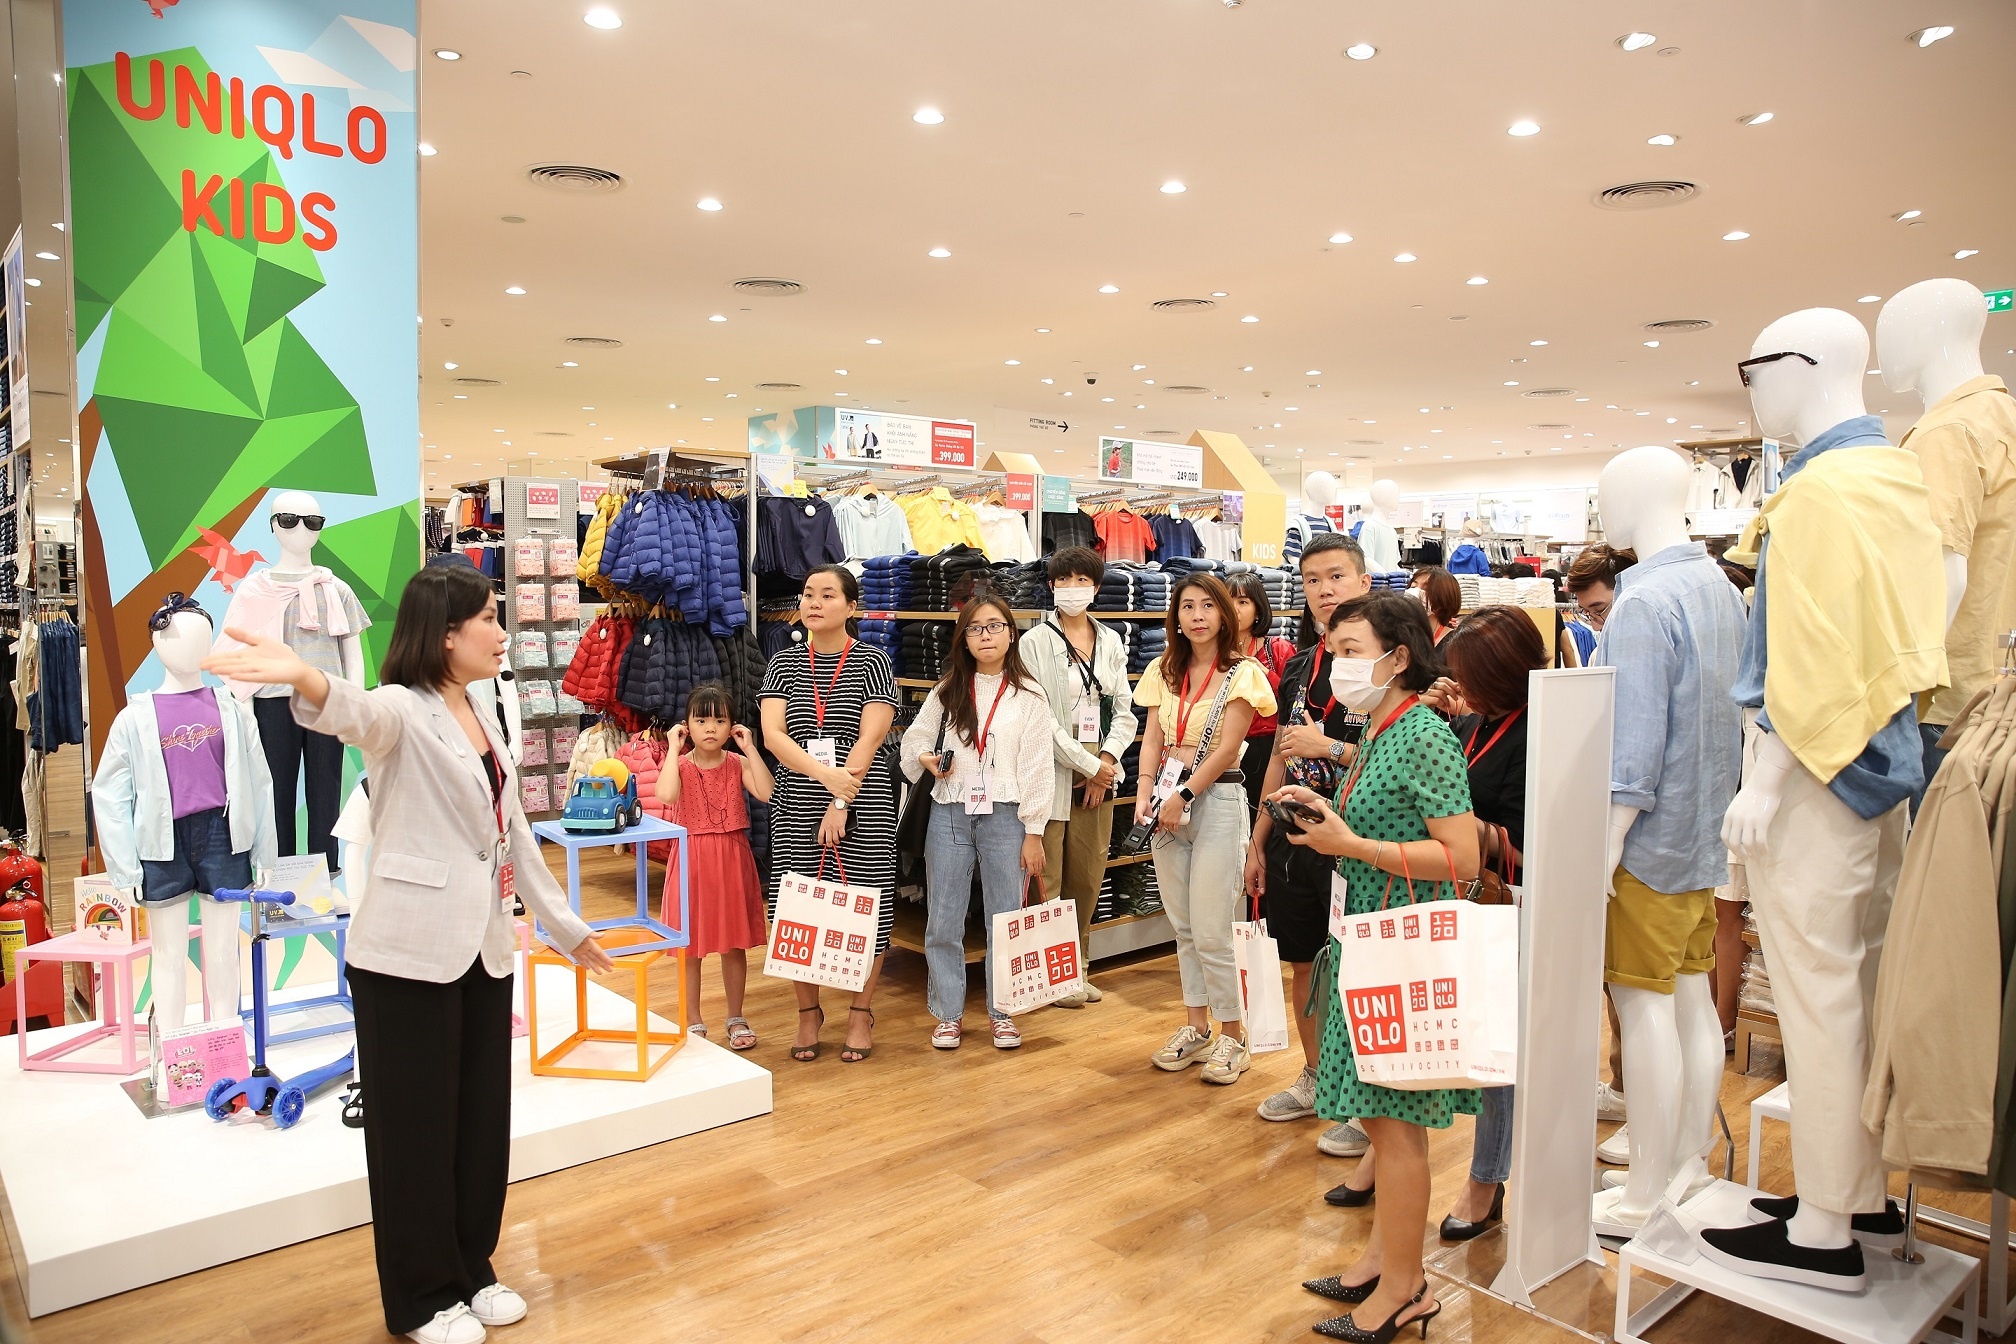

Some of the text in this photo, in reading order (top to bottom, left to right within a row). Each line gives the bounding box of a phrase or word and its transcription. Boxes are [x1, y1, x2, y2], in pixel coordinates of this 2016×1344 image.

[114, 51, 387, 165] UNIQLO
[181, 168, 338, 252] KIDS
[940, 451, 965, 462] 399.000
[1177, 471, 1198, 482] 249.000
[1012, 492, 1031, 501] 399.000
[1252, 543, 1276, 560] KIDS
[835, 892, 846, 900] UNI
[858, 895, 871, 906] ユニ
[79, 894, 127, 913] RAINBOW
[1404, 918, 1417, 927] UNI
[1433, 914, 1452, 925] ユニ
[780, 925, 810, 944] UNI
[828, 931, 841, 940] ユニ
[1404, 926, 1418, 938] QLO
[1433, 927, 1454, 938] クロ
[826, 939, 840, 947] クロ
[851, 936, 864, 944] UNI
[778, 942, 809, 960] QLO
[849, 943, 863, 952] QLO
[1026, 953, 1037, 961] UNI
[1049, 946, 1072, 964] ユニ
[1013, 965, 1020, 974] クロ
[1052, 963, 1073, 980] クロ
[1411, 984, 1425, 996] ユニ
[1435, 981, 1452, 993] UNI
[1352, 993, 1396, 1020] UNI
[1412, 997, 1426, 1008] クロ
[1435, 994, 1455, 1008] QLO
[1357, 1022, 1401, 1051] QLO
